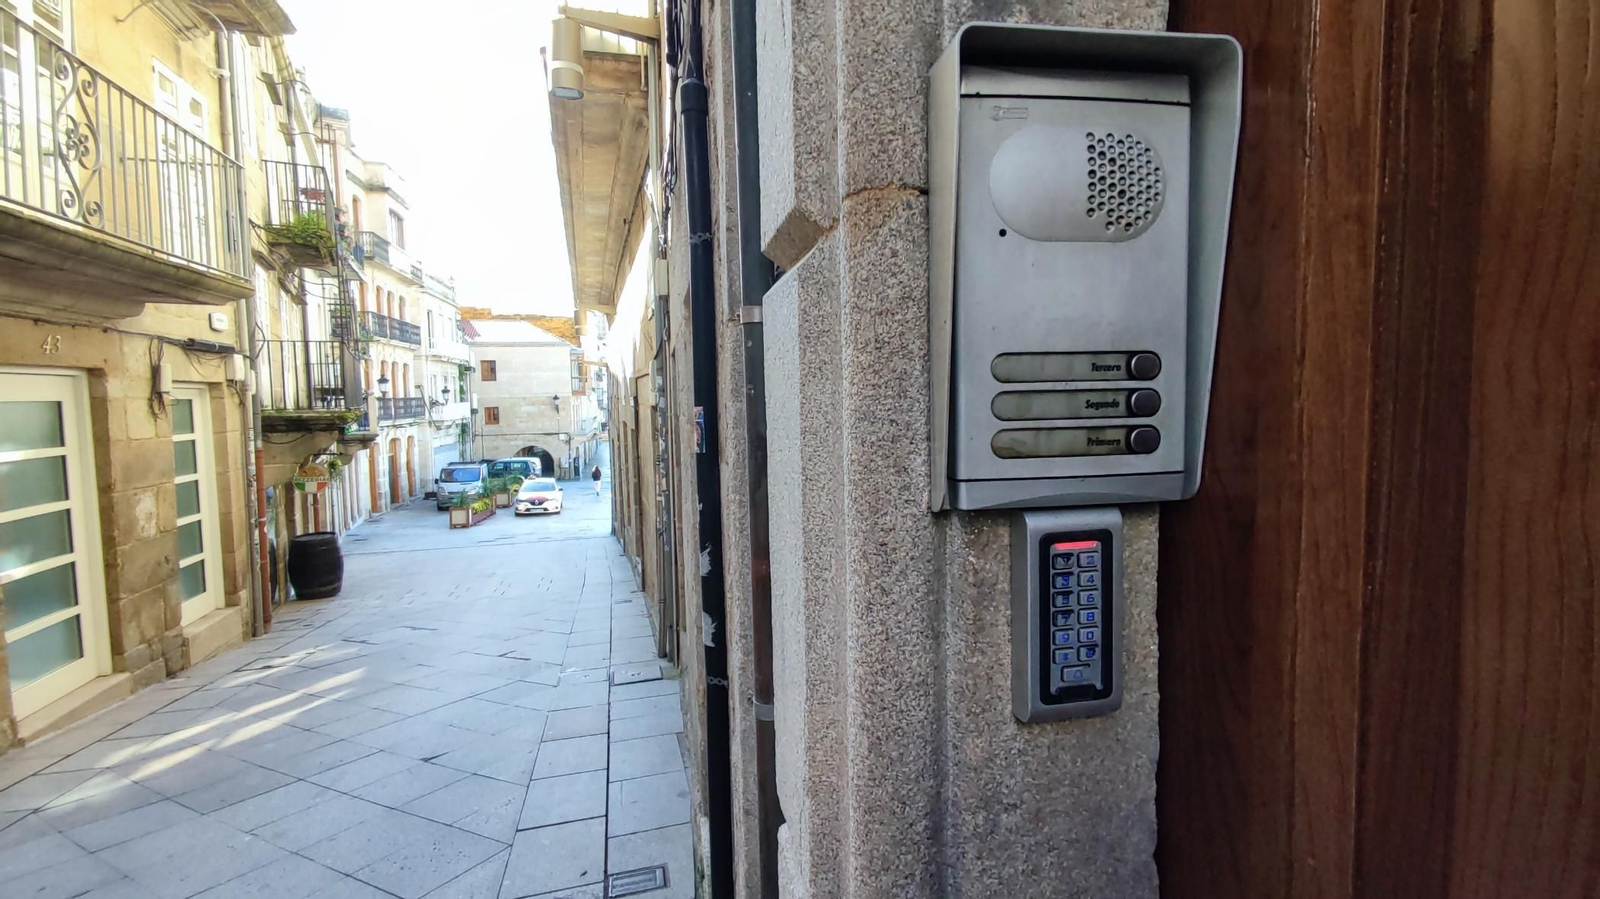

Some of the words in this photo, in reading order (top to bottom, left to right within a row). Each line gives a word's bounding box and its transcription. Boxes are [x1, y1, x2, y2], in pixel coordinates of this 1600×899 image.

[41, 334, 62, 355] 43
[1091, 362, 1122, 373] Tercero
[1084, 398, 1121, 411] Segundo
[1086, 436, 1122, 447] Primero
[1087, 555, 1095, 566] 2
[1087, 574, 1095, 584] 4
[1087, 593, 1095, 603] 6
[1087, 611, 1095, 622] 8
[1062, 632, 1070, 643] 9
[1087, 630, 1095, 641] 0
